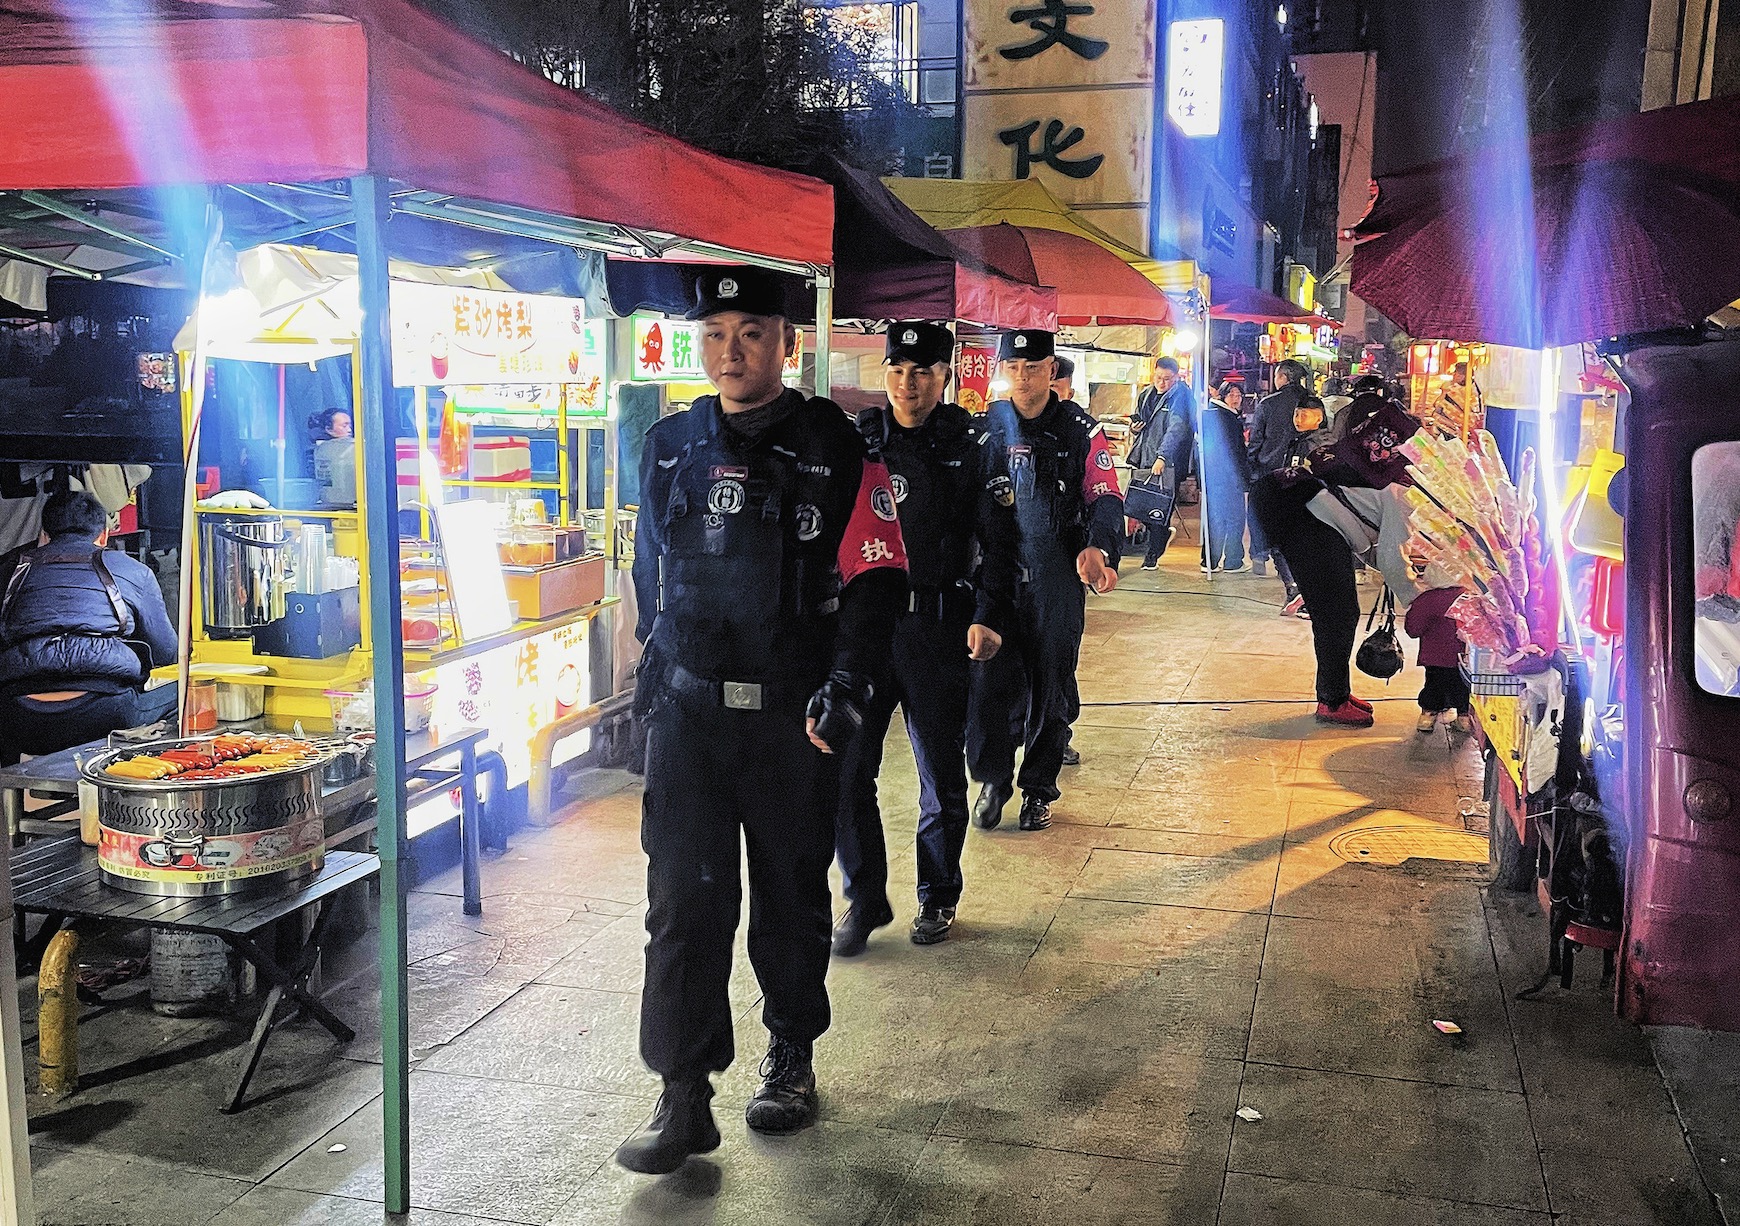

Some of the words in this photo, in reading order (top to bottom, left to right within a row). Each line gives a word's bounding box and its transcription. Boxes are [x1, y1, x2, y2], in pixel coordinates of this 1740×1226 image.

[1000, 0, 1109, 179] 文化
[453, 294, 532, 339] 紫砂烤梨
[672, 331, 700, 368] 铁
[861, 538, 894, 563] 执
